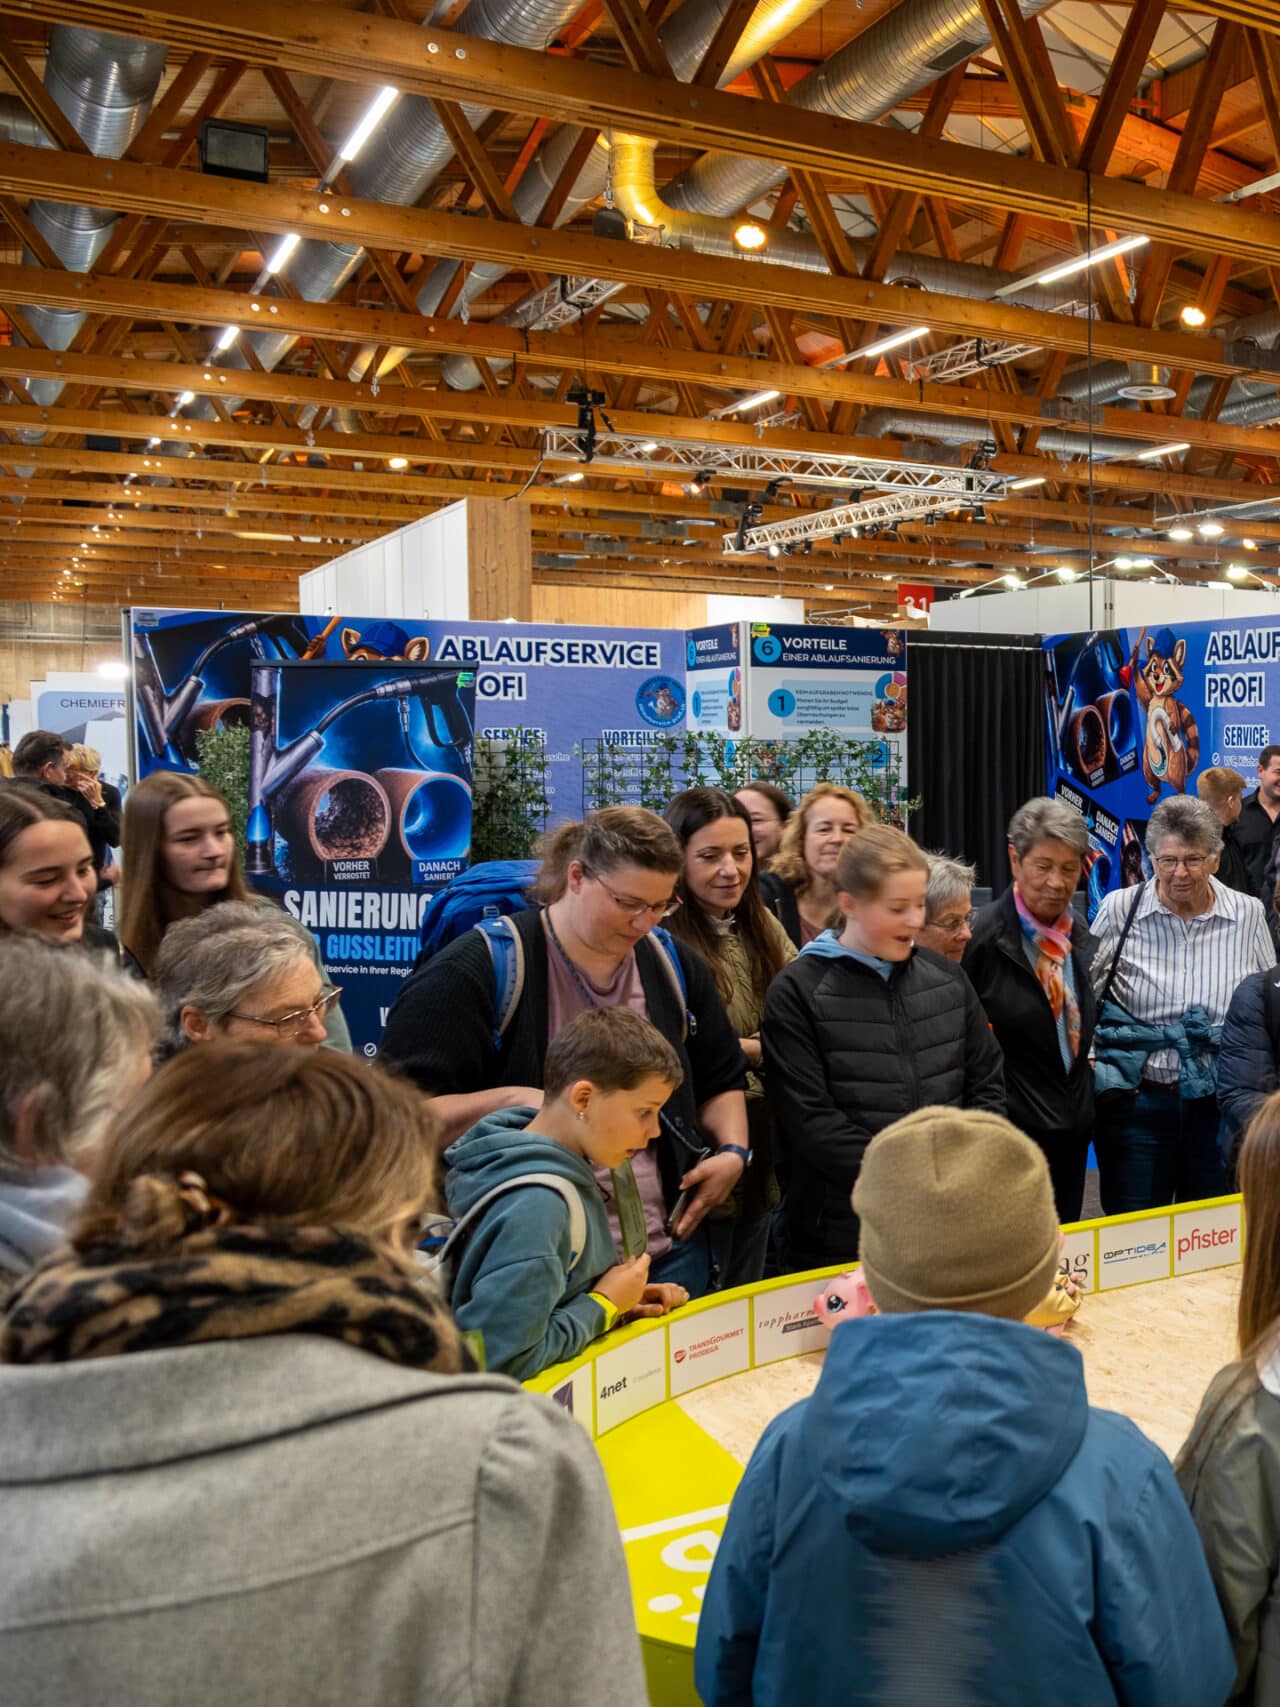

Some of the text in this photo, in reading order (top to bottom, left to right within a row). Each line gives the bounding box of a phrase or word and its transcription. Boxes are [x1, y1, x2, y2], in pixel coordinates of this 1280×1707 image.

[437, 637, 660, 668] ABLAUFSERVICE
[761, 640, 774, 657] 6
[782, 637, 847, 651] VORTEILE
[782, 652, 897, 665] EINER ABLAUFSANIERUNG
[475, 673, 526, 698] OFI
[1206, 673, 1265, 706] PROFI
[777, 695, 785, 711] 1
[1223, 725, 1270, 748] SERVICE:
[1060, 783, 1083, 809] VORHER
[1096, 811, 1119, 836] DANACH
[1094, 821, 1118, 847] SANIERT
[332, 860, 370, 872] VORHER
[333, 871, 371, 881] VERROSTET
[418, 860, 461, 872] DANACH
[423, 872, 456, 881] SANIERT
[360, 964, 369, 973] in
[369, 964, 389, 974] Ihrer
[1178, 1227, 1237, 1261] pfister
[600, 1375, 628, 1400] 4net
